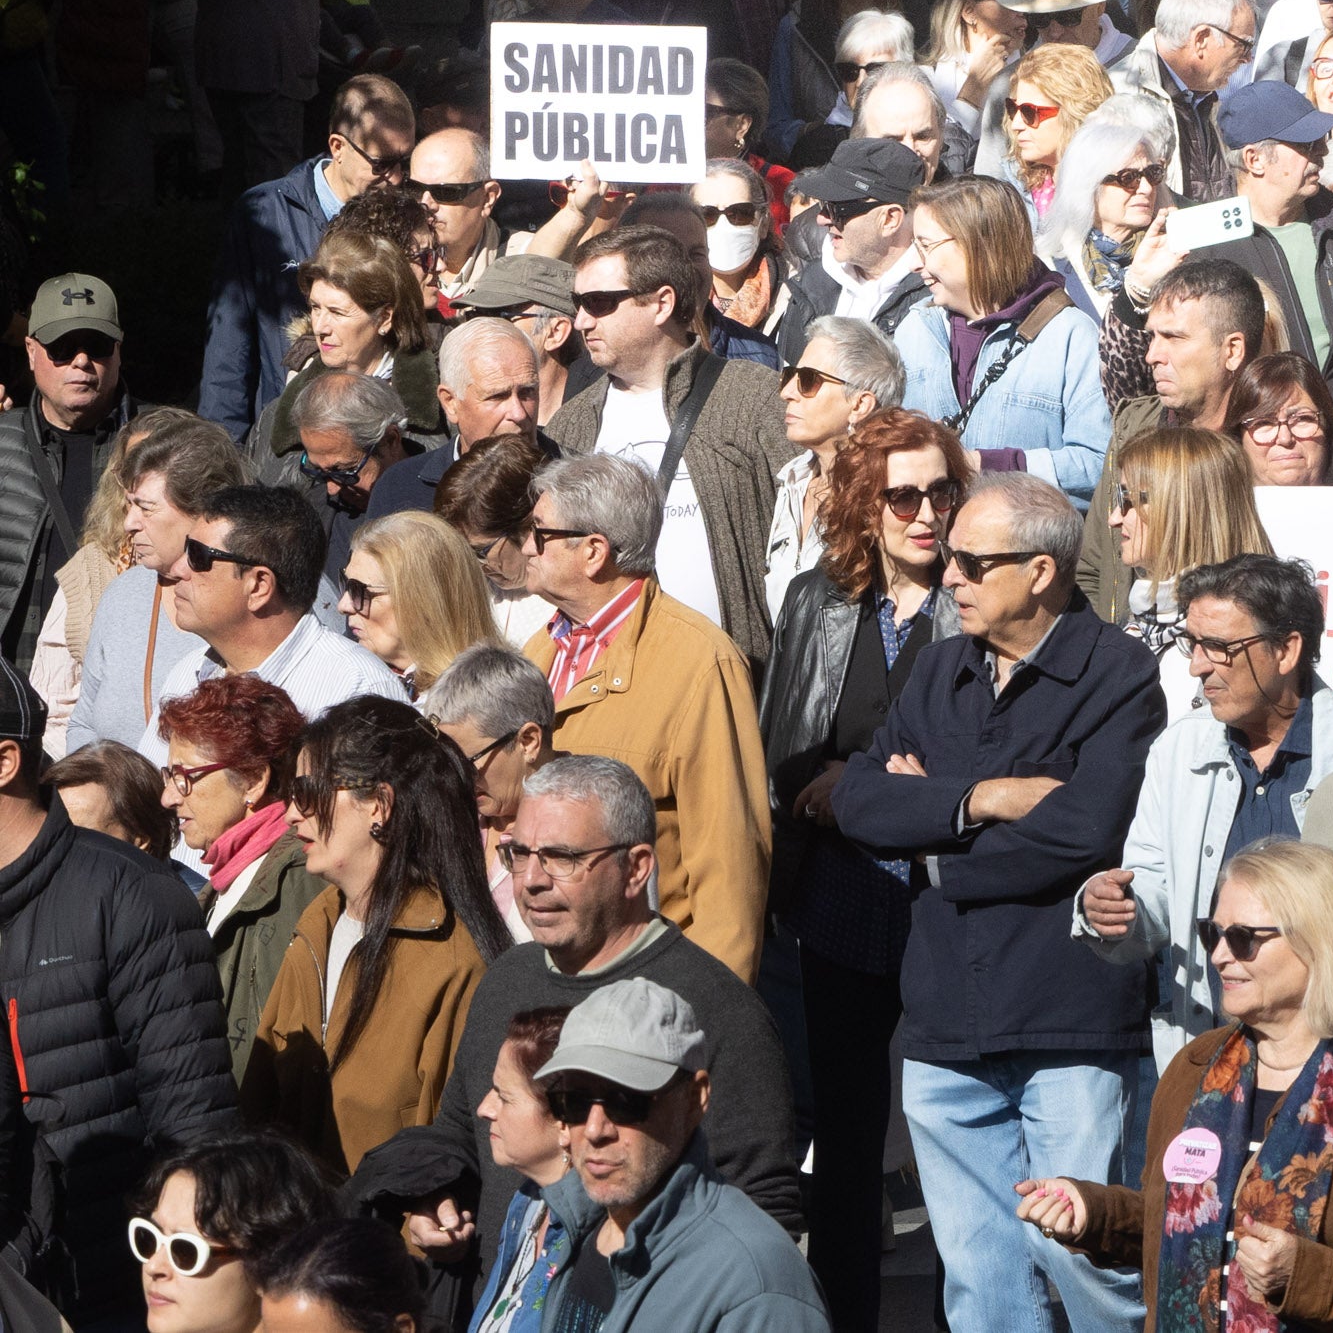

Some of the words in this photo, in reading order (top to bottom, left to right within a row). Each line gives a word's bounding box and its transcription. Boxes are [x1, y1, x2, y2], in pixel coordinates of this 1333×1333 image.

[504, 42, 694, 96] SANIDAD
[505, 102, 688, 164] PÚBLICA
[1185, 1147, 1206, 1157] MATA
